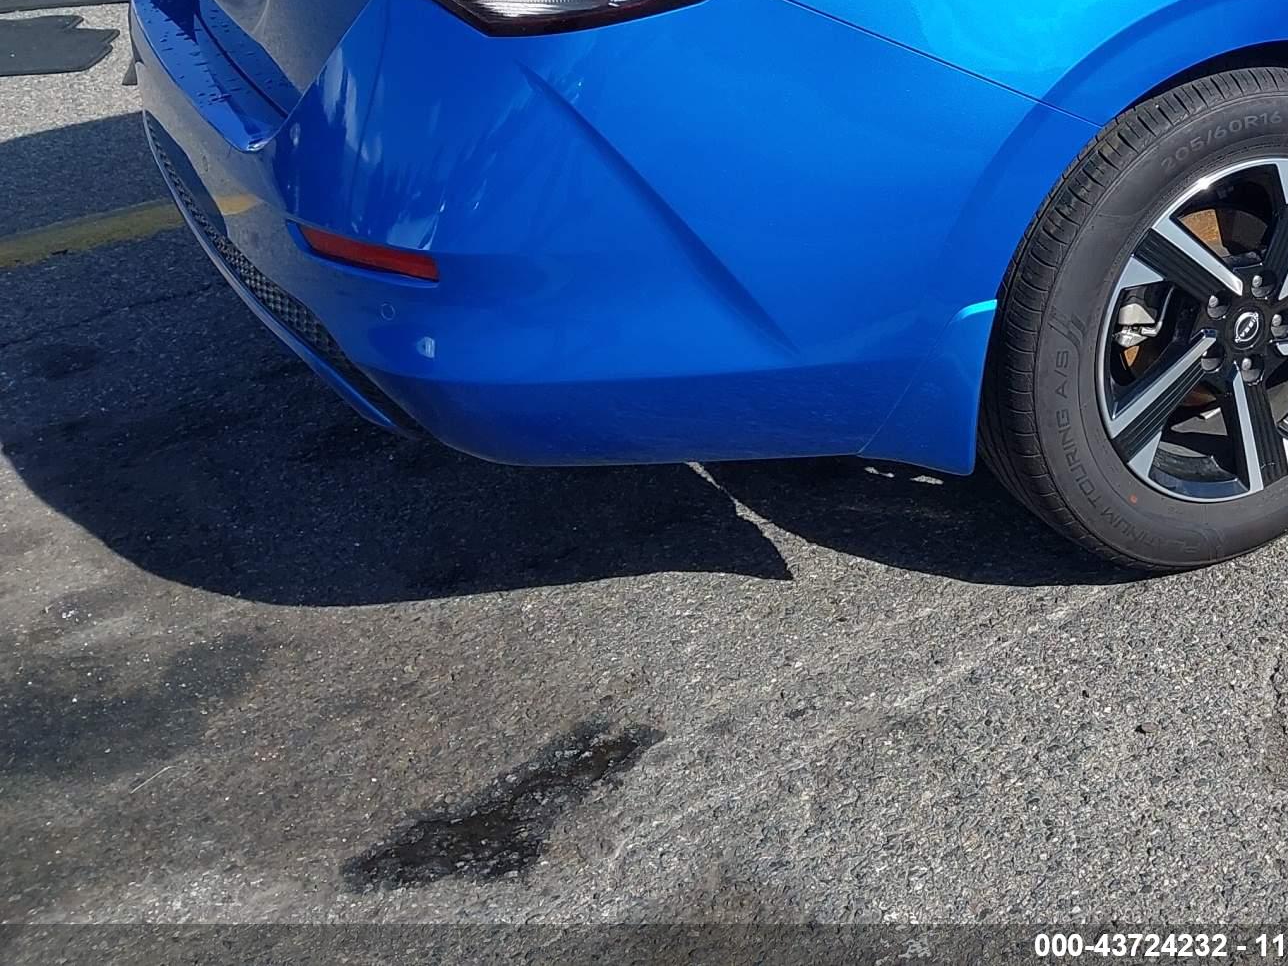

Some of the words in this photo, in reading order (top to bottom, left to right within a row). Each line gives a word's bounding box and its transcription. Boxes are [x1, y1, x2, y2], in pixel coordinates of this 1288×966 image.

[1160, 110, 1283, 172] 205/60R16
[1054, 350, 1070, 399] A/S
[1056, 408, 1102, 508] TOURING
